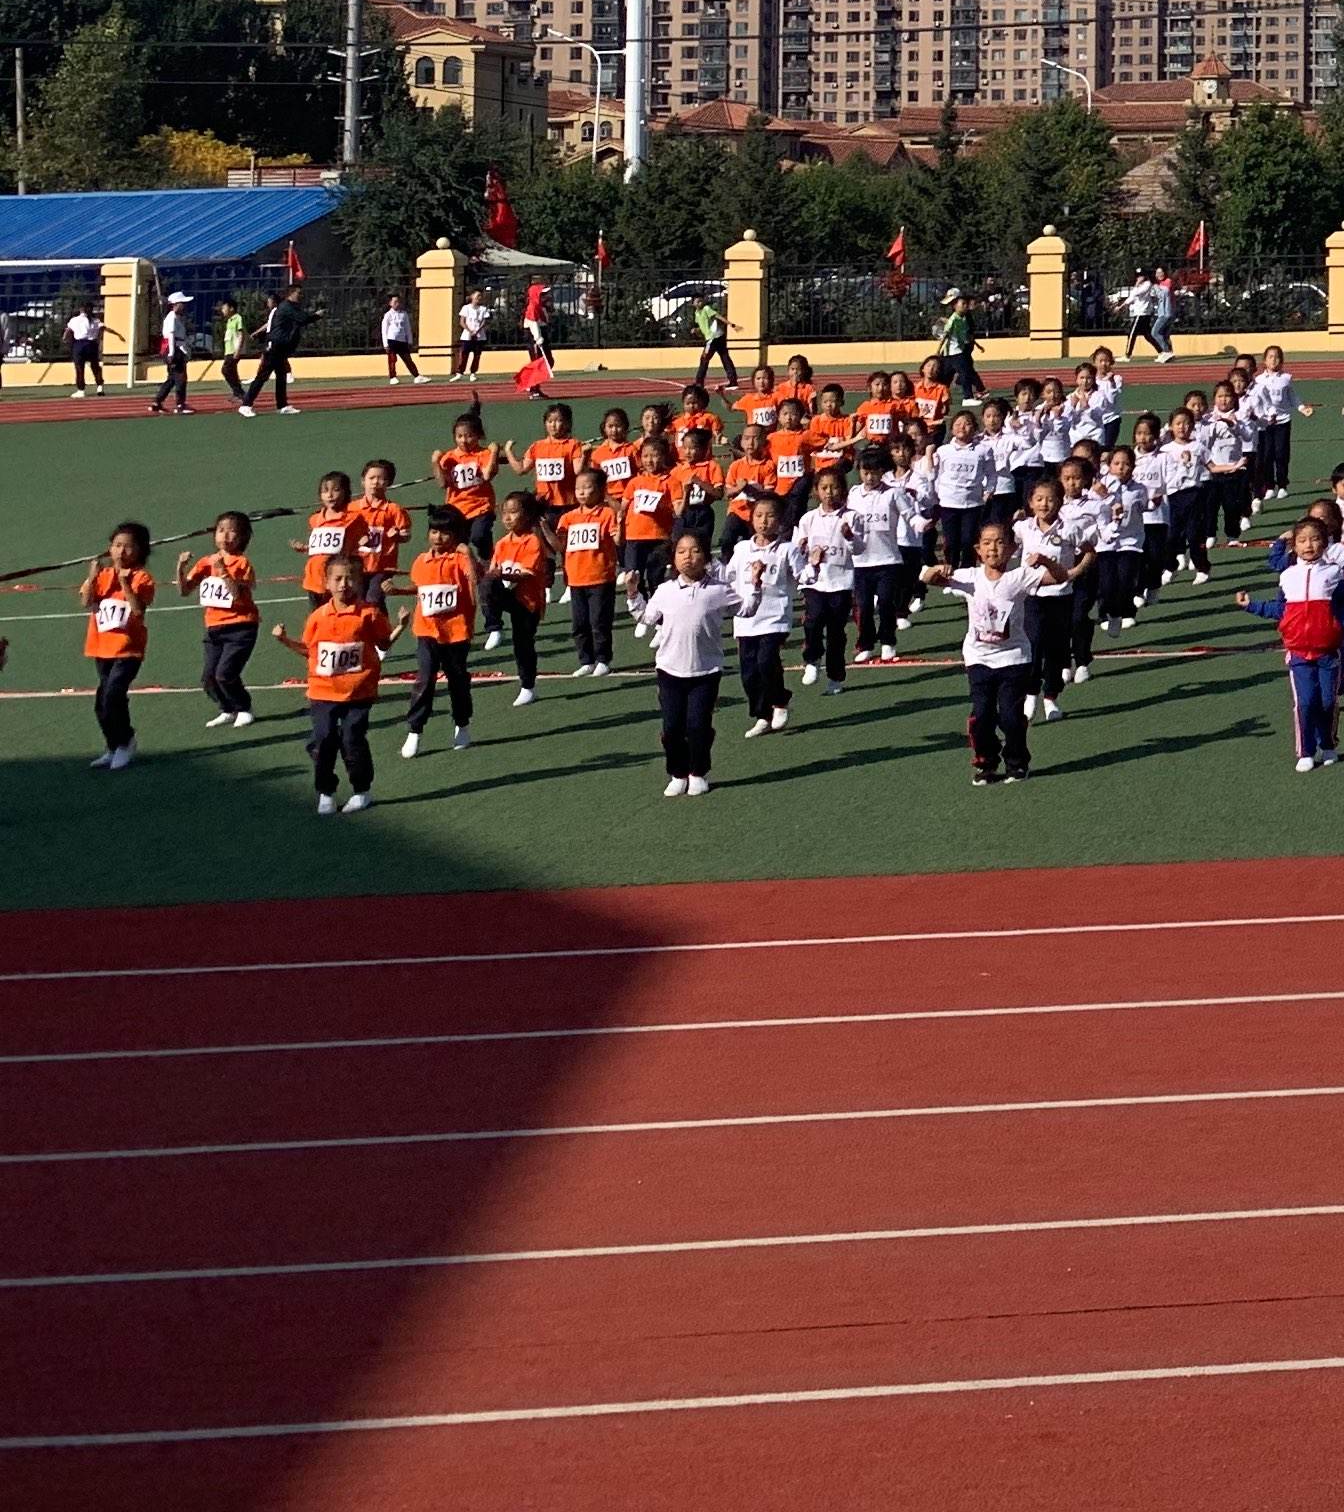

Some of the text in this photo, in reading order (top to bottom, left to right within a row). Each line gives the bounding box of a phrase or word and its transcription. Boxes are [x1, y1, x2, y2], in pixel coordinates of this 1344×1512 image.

[453, 467, 475, 483] 213
[537, 463, 562, 476] 2133
[866, 512, 887, 524] 234
[310, 532, 342, 549] 2135
[570, 528, 597, 546] 2103
[823, 545, 845, 558] 231
[744, 561, 777, 575] 26
[320, 648, 361, 669] 2105
